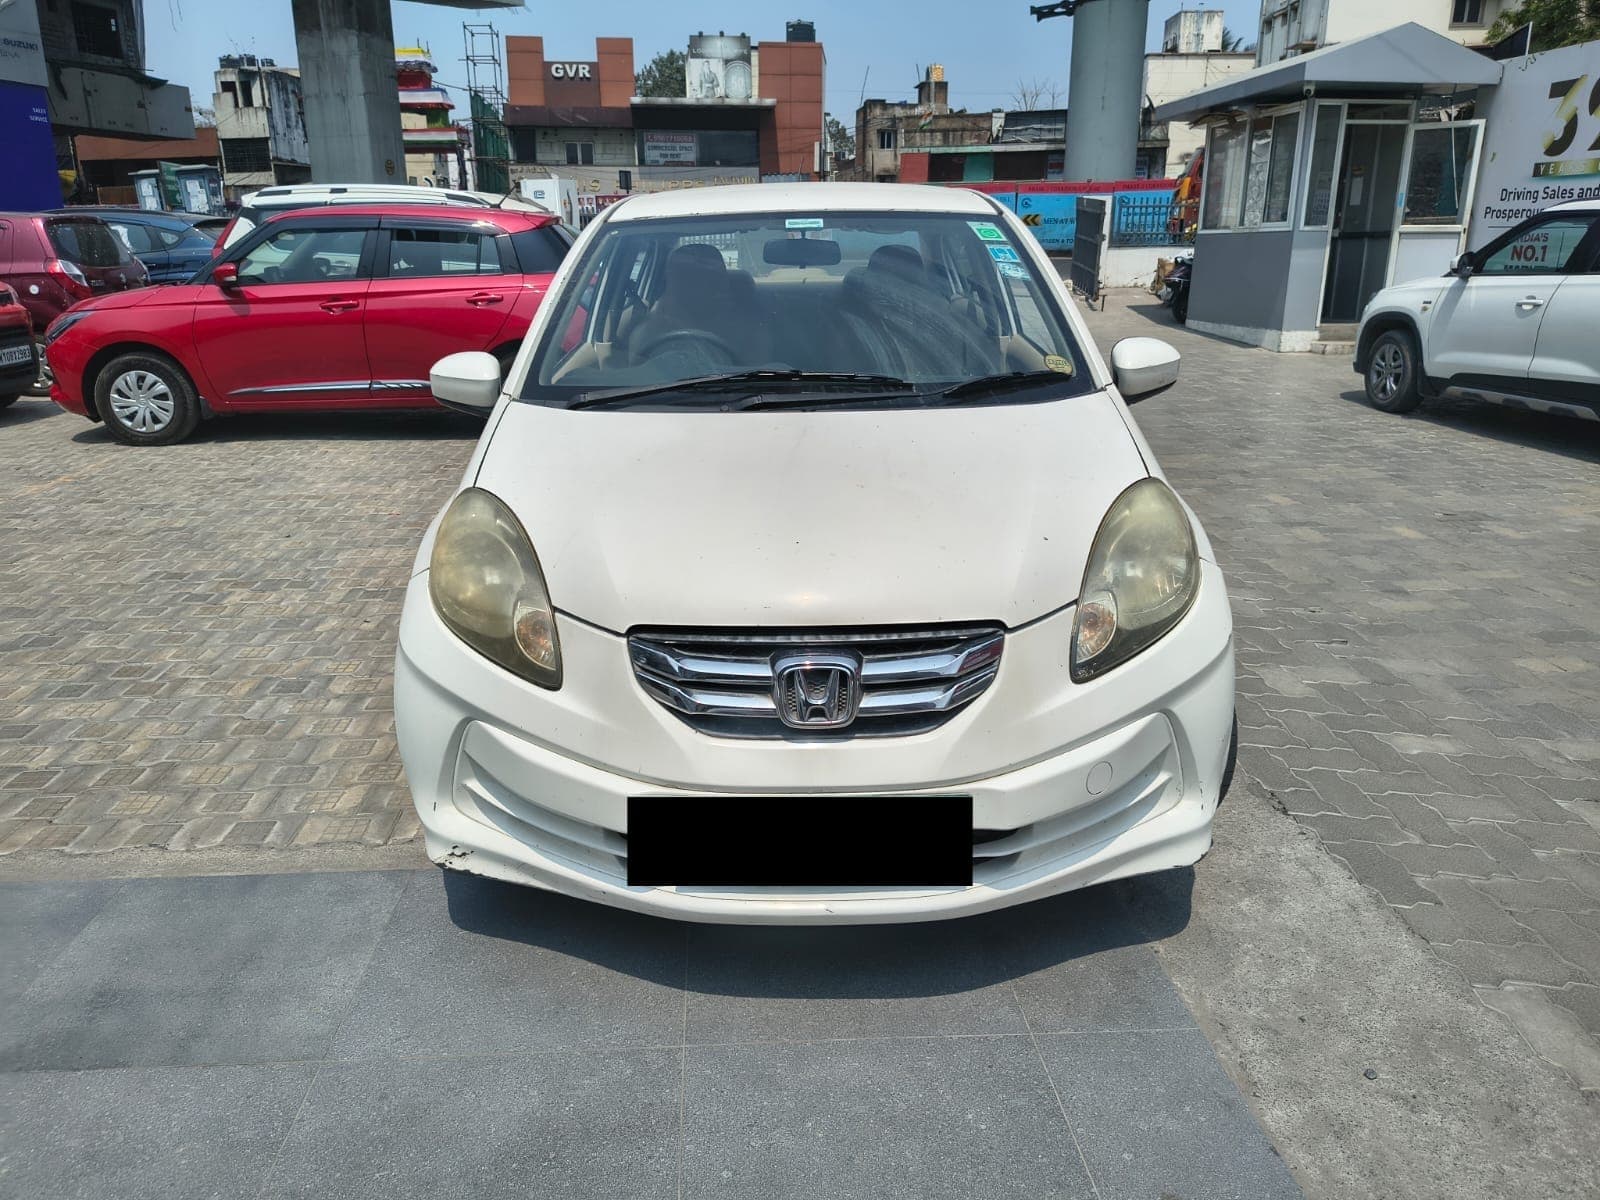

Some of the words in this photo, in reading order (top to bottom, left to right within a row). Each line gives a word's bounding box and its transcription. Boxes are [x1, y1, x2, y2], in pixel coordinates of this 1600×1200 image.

[3, 38, 39, 51] SUZUKI
[551, 63, 592, 79] GVR
[1500, 187, 1540, 203] Driving
[1542, 185, 1575, 200] Sales
[1577, 184, 1600, 199] and
[1484, 206, 1545, 221] Prosperou
[1510, 244, 1548, 262] NO.1
